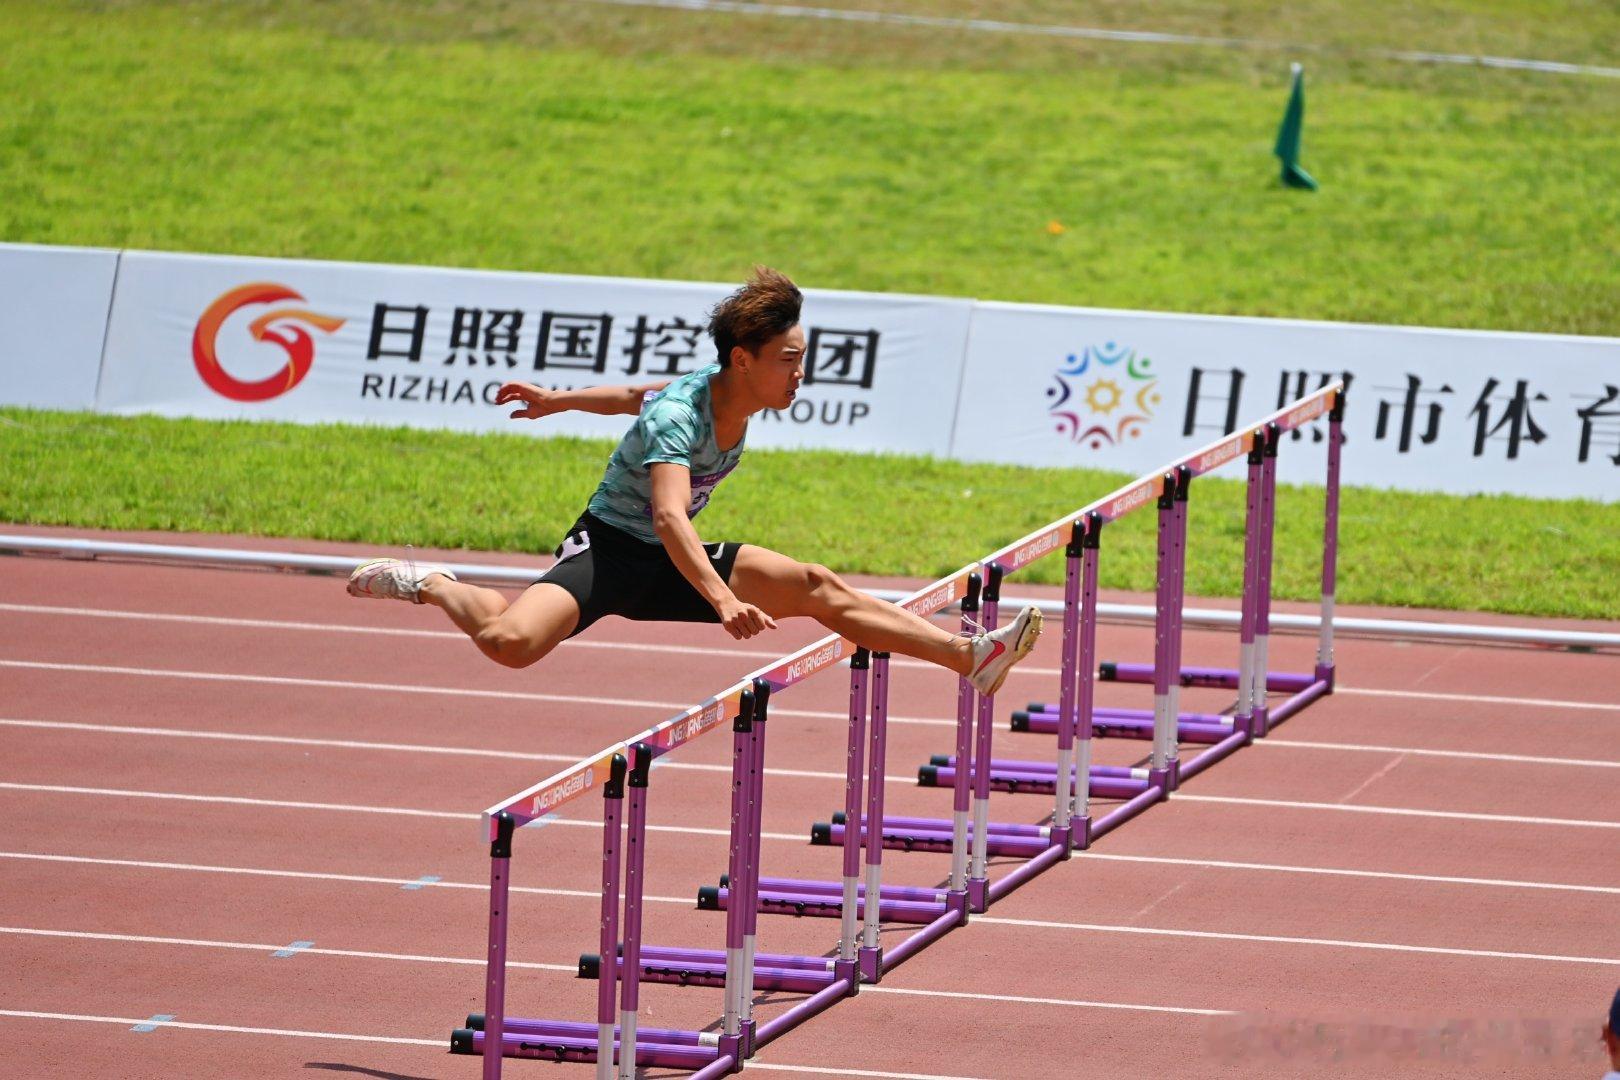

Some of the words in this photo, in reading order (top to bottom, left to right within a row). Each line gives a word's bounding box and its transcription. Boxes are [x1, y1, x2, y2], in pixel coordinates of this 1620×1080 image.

[366, 302, 880, 389] 日照国控团
